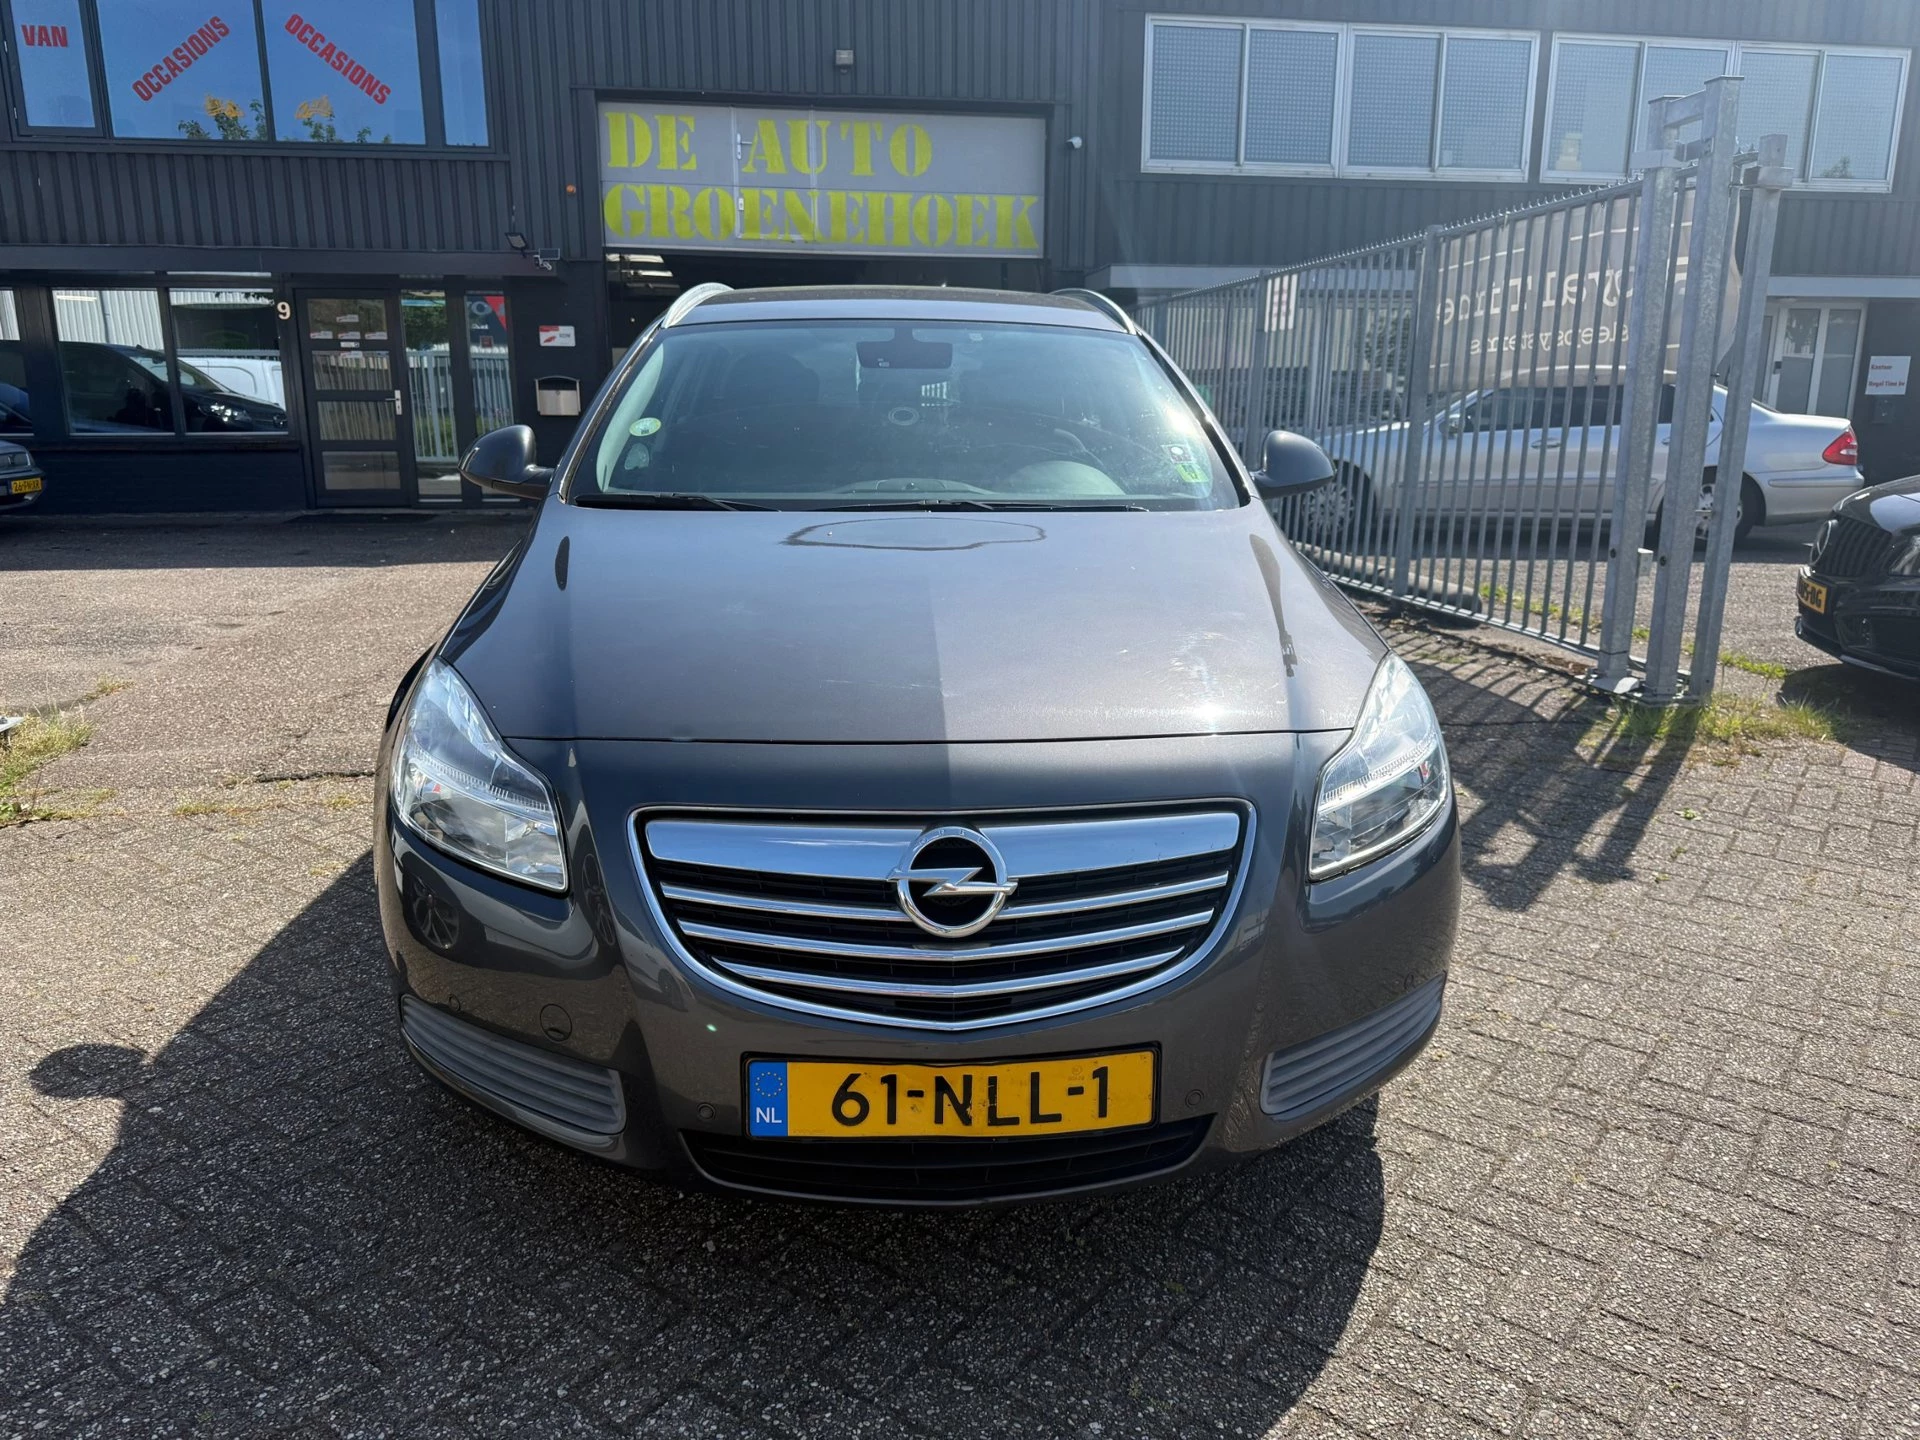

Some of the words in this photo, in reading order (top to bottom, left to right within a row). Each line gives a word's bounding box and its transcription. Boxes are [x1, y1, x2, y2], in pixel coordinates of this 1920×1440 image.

[21, 25, 68, 48] VAN
[132, 16, 231, 102] OCCASIONS
[284, 13, 392, 105] OCCASIONS
[604, 112, 697, 171] DE
[741, 119, 933, 177] AUTO
[603, 182, 1040, 250] GROENEHOEK
[277, 301, 291, 320] 9
[756, 1107, 782, 1123] NL
[831, 1065, 1109, 1127] 61-NLL-1
